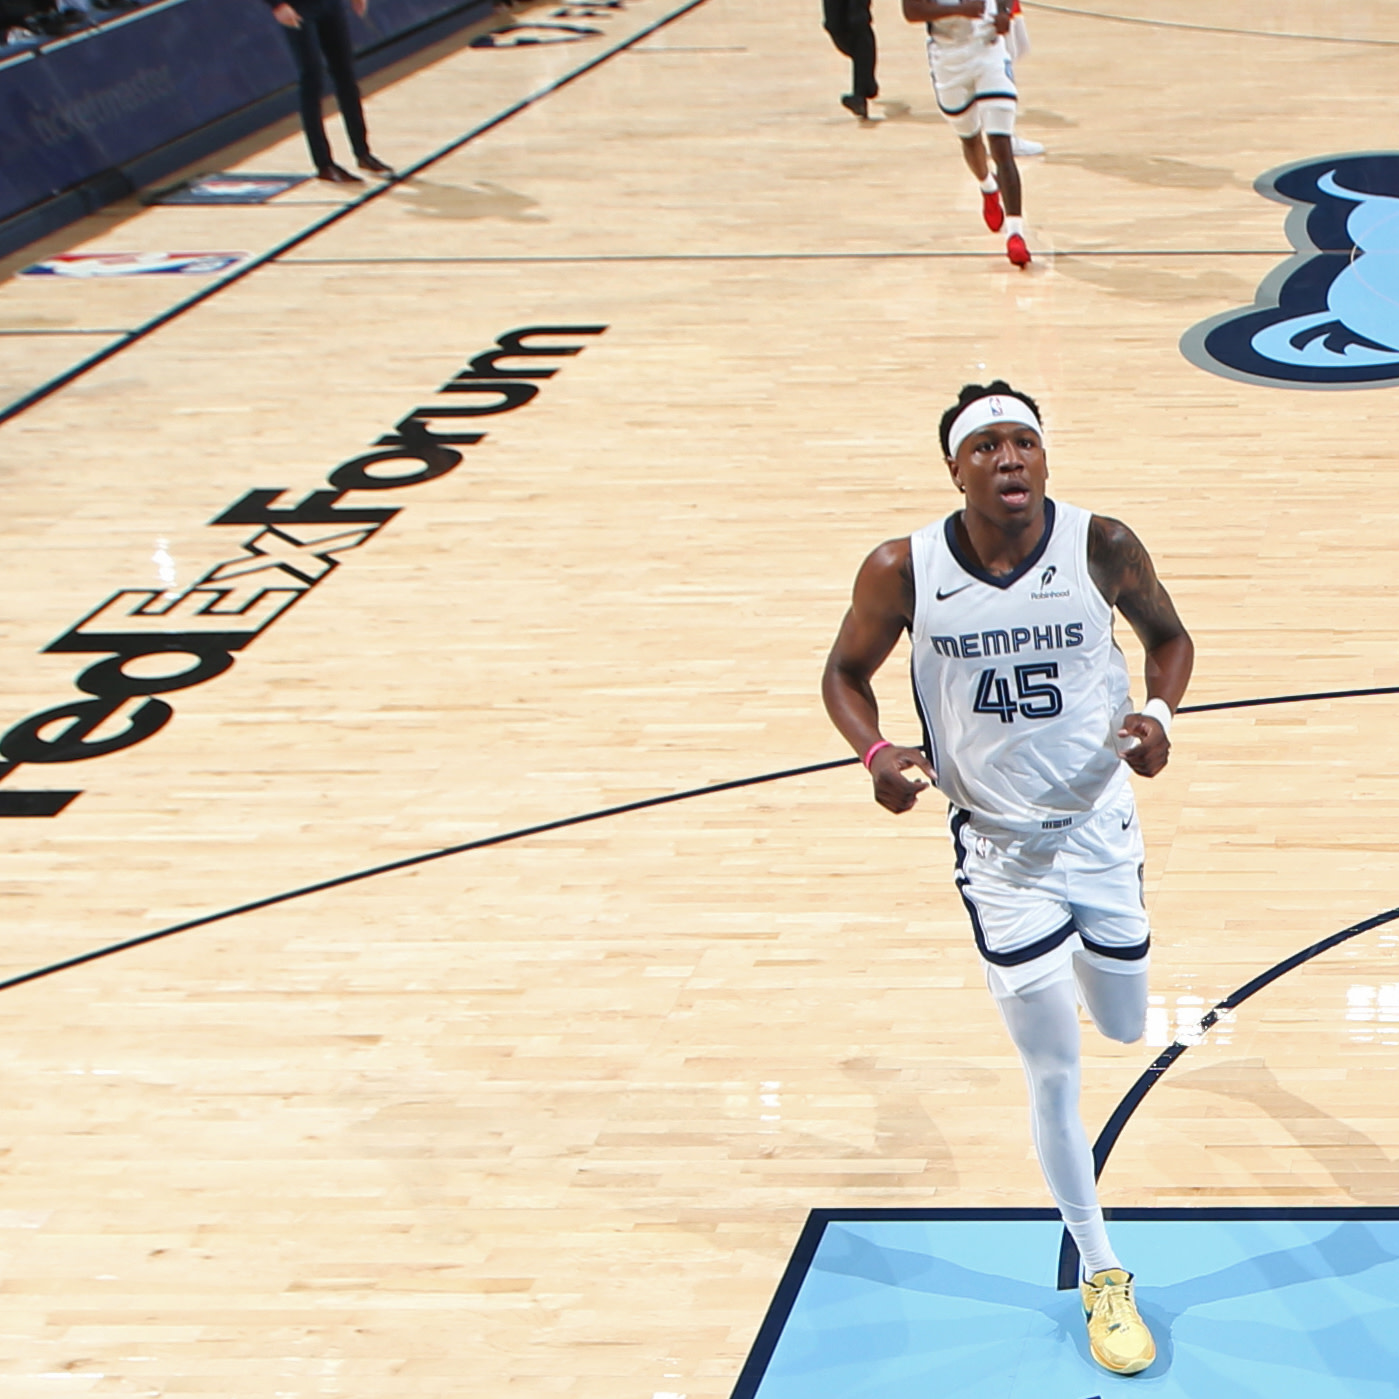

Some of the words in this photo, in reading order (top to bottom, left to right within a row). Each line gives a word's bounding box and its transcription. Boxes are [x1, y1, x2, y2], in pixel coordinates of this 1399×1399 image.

[1031, 589, 1070, 600] Robinhood
[931, 622, 1083, 658] MEMPHIS
[973, 662, 1063, 723] 45
